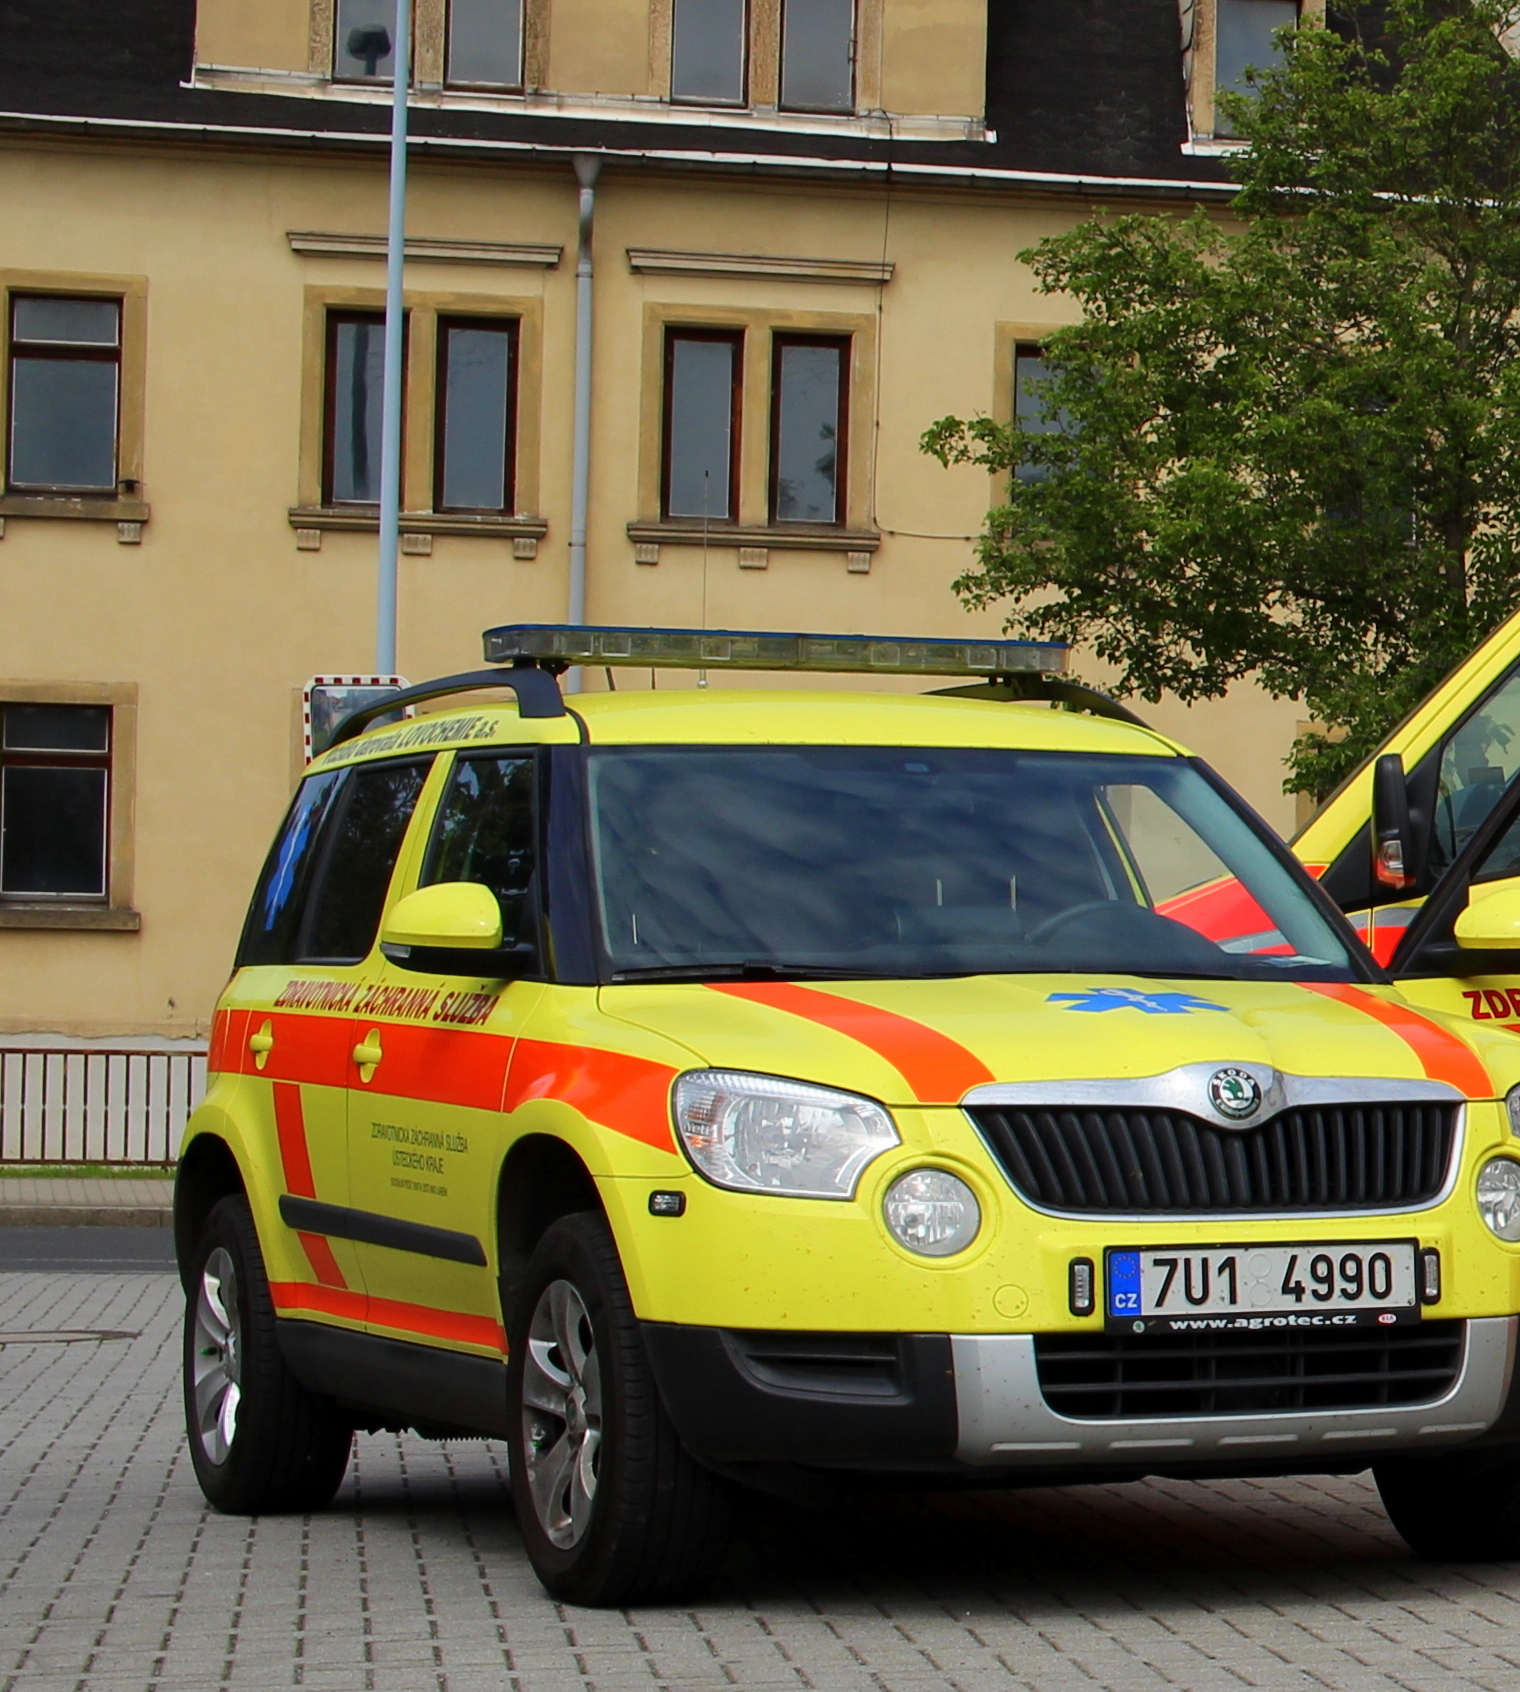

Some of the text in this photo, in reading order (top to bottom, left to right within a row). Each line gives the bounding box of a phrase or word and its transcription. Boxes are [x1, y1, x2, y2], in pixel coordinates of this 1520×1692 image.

[273, 976, 500, 1026] ZDRAVOTNICKÁ ZÁCHRANNÁ SLUŽBA
[1115, 1252, 1393, 1308] CZ 7U1 4990
[1169, 1313, 1357, 1330] www.agrotec.cz
